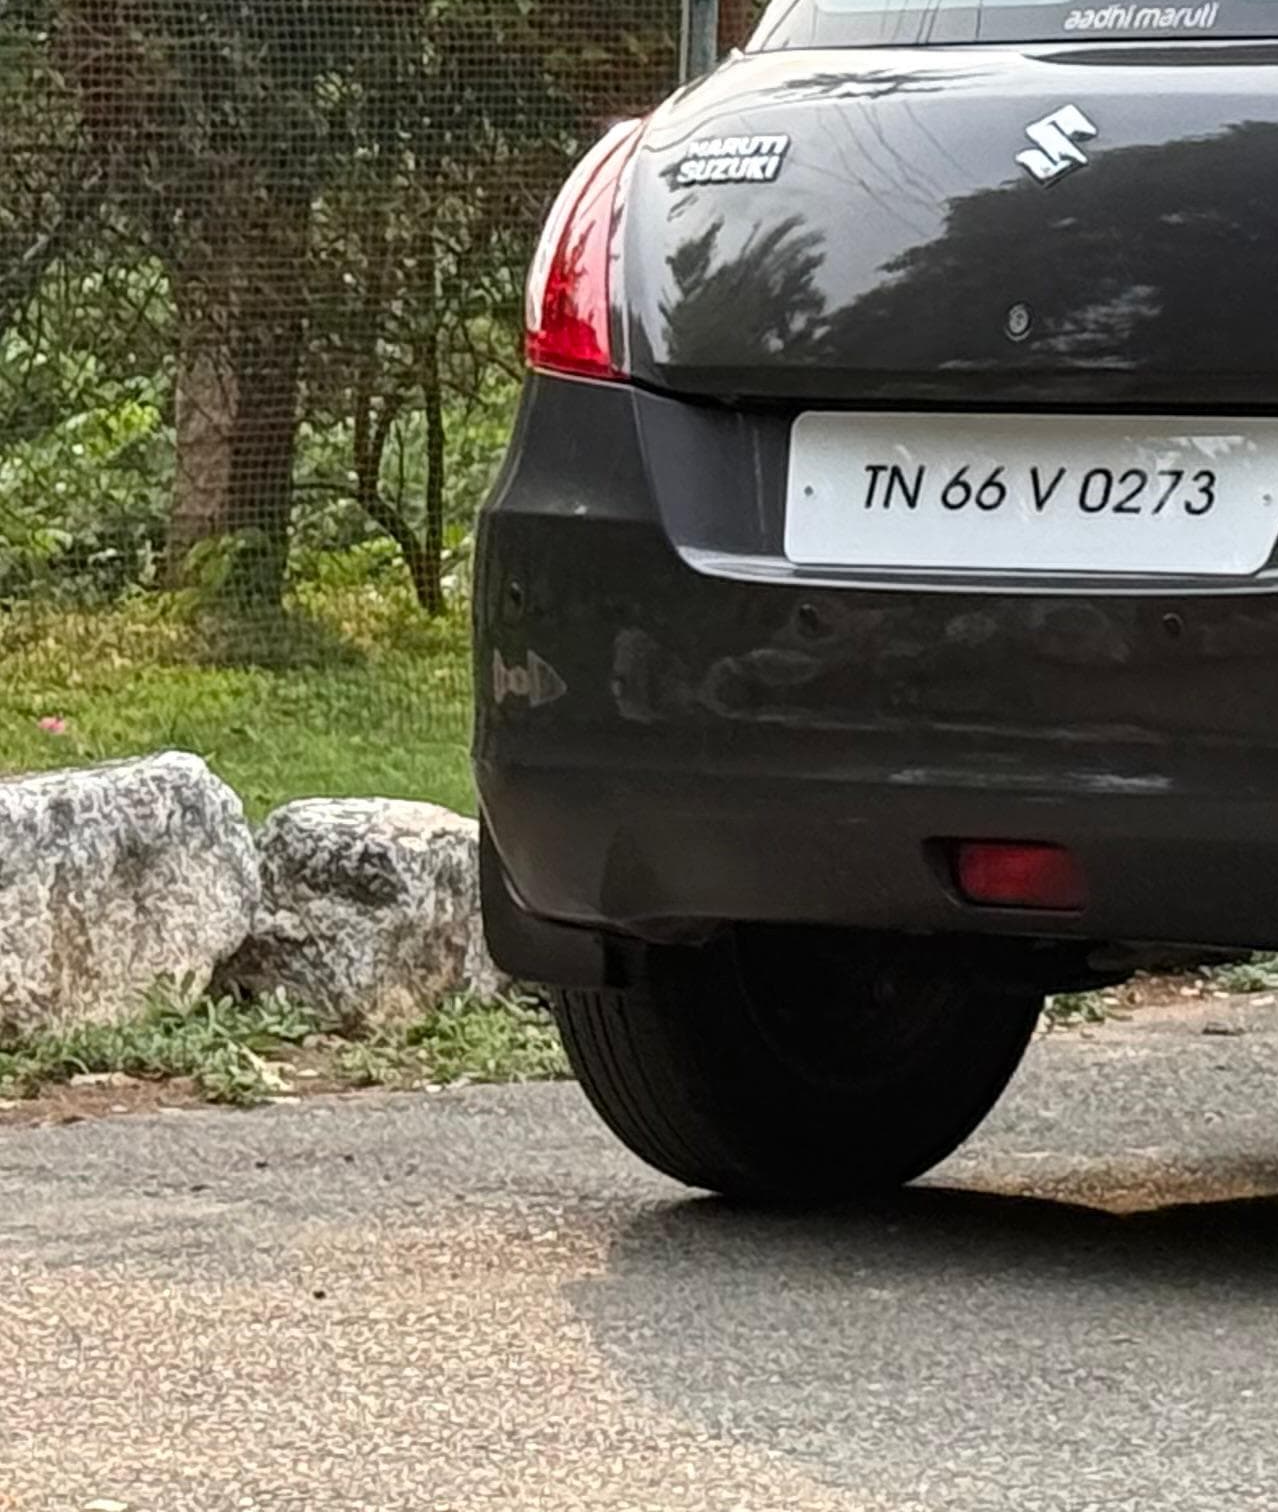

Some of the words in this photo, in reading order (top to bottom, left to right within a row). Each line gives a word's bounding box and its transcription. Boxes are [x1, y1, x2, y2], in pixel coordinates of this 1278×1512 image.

[677, 155, 780, 183] SUZUKI
[864, 464, 926, 510] TN
[940, 465, 1007, 511] 66
[1030, 466, 1067, 512] V
[1078, 469, 1218, 515] 0273
